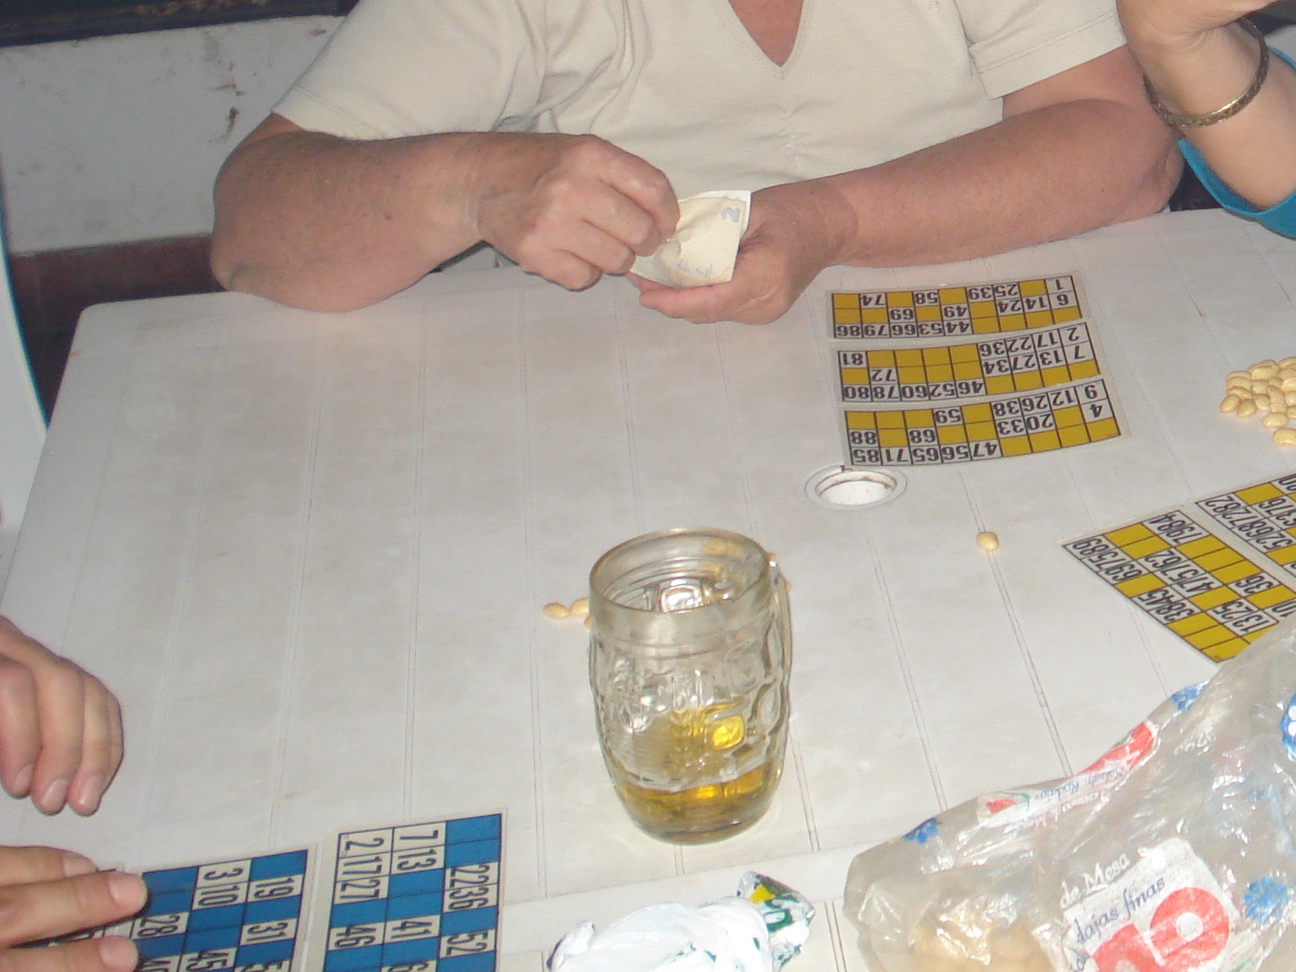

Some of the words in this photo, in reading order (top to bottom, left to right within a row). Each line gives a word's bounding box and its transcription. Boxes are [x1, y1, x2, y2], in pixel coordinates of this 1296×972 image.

[995, 284, 1019, 296] 25
[1054, 278, 1064, 290] 1
[861, 294, 883, 307] 74
[915, 292, 938, 304] 58
[969, 286, 993, 300] 39
[1056, 294, 1069, 306] 6
[998, 299, 1022, 314] 24
[1024, 296, 1048, 310] 14
[890, 308, 914, 320] 69
[943, 305, 968, 318] 49
[837, 324, 861, 337] 86
[864, 323, 888, 337] 79
[892, 322, 917, 336] 66
[919, 322, 942, 335] 53
[945, 320, 970, 333] 44
[1067, 327, 1079, 341] 2
[1006, 338, 1031, 353] 22
[1037, 332, 1058, 348] 17
[980, 344, 1004, 357] 36
[1040, 350, 1062, 365] 13
[1074, 346, 1085, 359] 7
[842, 353, 864, 366] 81
[1012, 354, 1036, 370] 27
[871, 368, 896, 382] 72
[982, 360, 1008, 375] 34
[844, 386, 870, 400] 80
[873, 385, 899, 400] 78
[902, 384, 927, 399] 60
[929, 382, 956, 397] 52
[958, 380, 984, 395] 46
[1085, 385, 1097, 399] 9
[1021, 396, 1047, 412] 26
[1051, 391, 1076, 406] 12
[935, 409, 961, 424] 59
[994, 402, 1019, 417] 38
[1089, 404, 1103, 419] 4
[997, 419, 1024, 435] 33
[1025, 414, 1053, 430] 20
[851, 430, 877, 445] 88
[909, 429, 935, 443] 68
[853, 449, 880, 464] 85
[886, 448, 909, 464] 71
[913, 448, 939, 463] 65
[941, 444, 970, 460] 56
[970, 442, 998, 457] 47
[1205, 495, 1240, 513] 82
[1258, 497, 1293, 515] 76
[1149, 513, 1184, 531] 84
[1221, 508, 1257, 526] 72
[1166, 526, 1206, 546] 79
[1238, 521, 1273, 537] 68
[1072, 538, 1105, 556] 89
[1255, 532, 1292, 550] 52
[1088, 551, 1121, 570] 75
[1144, 550, 1182, 569] 62
[1105, 563, 1142, 582] 69
[1161, 564, 1198, 583] 57
[1178, 575, 1215, 593] 47
[1235, 575, 1273, 594] 36
[1136, 588, 1174, 606] 45
[1155, 601, 1194, 622] 38
[1212, 601, 1248, 619] 25
[1232, 614, 1268, 632] 13
[399, 830, 438, 840] 7
[345, 837, 384, 851] 2
[342, 856, 382, 876] 17
[396, 849, 437, 871] 13
[203, 868, 243, 881] 3
[449, 864, 490, 888] 22
[1082, 853, 1130, 887] Mesa
[253, 877, 295, 898] 19
[339, 879, 380, 899] 27
[198, 884, 239, 907] 10
[448, 888, 489, 910] 36
[1123, 877, 1165, 920] finas
[137, 914, 180, 937] 28
[246, 922, 288, 942] 31
[391, 921, 432, 939] 41
[333, 924, 377, 948] 46
[446, 931, 488, 956] 52
